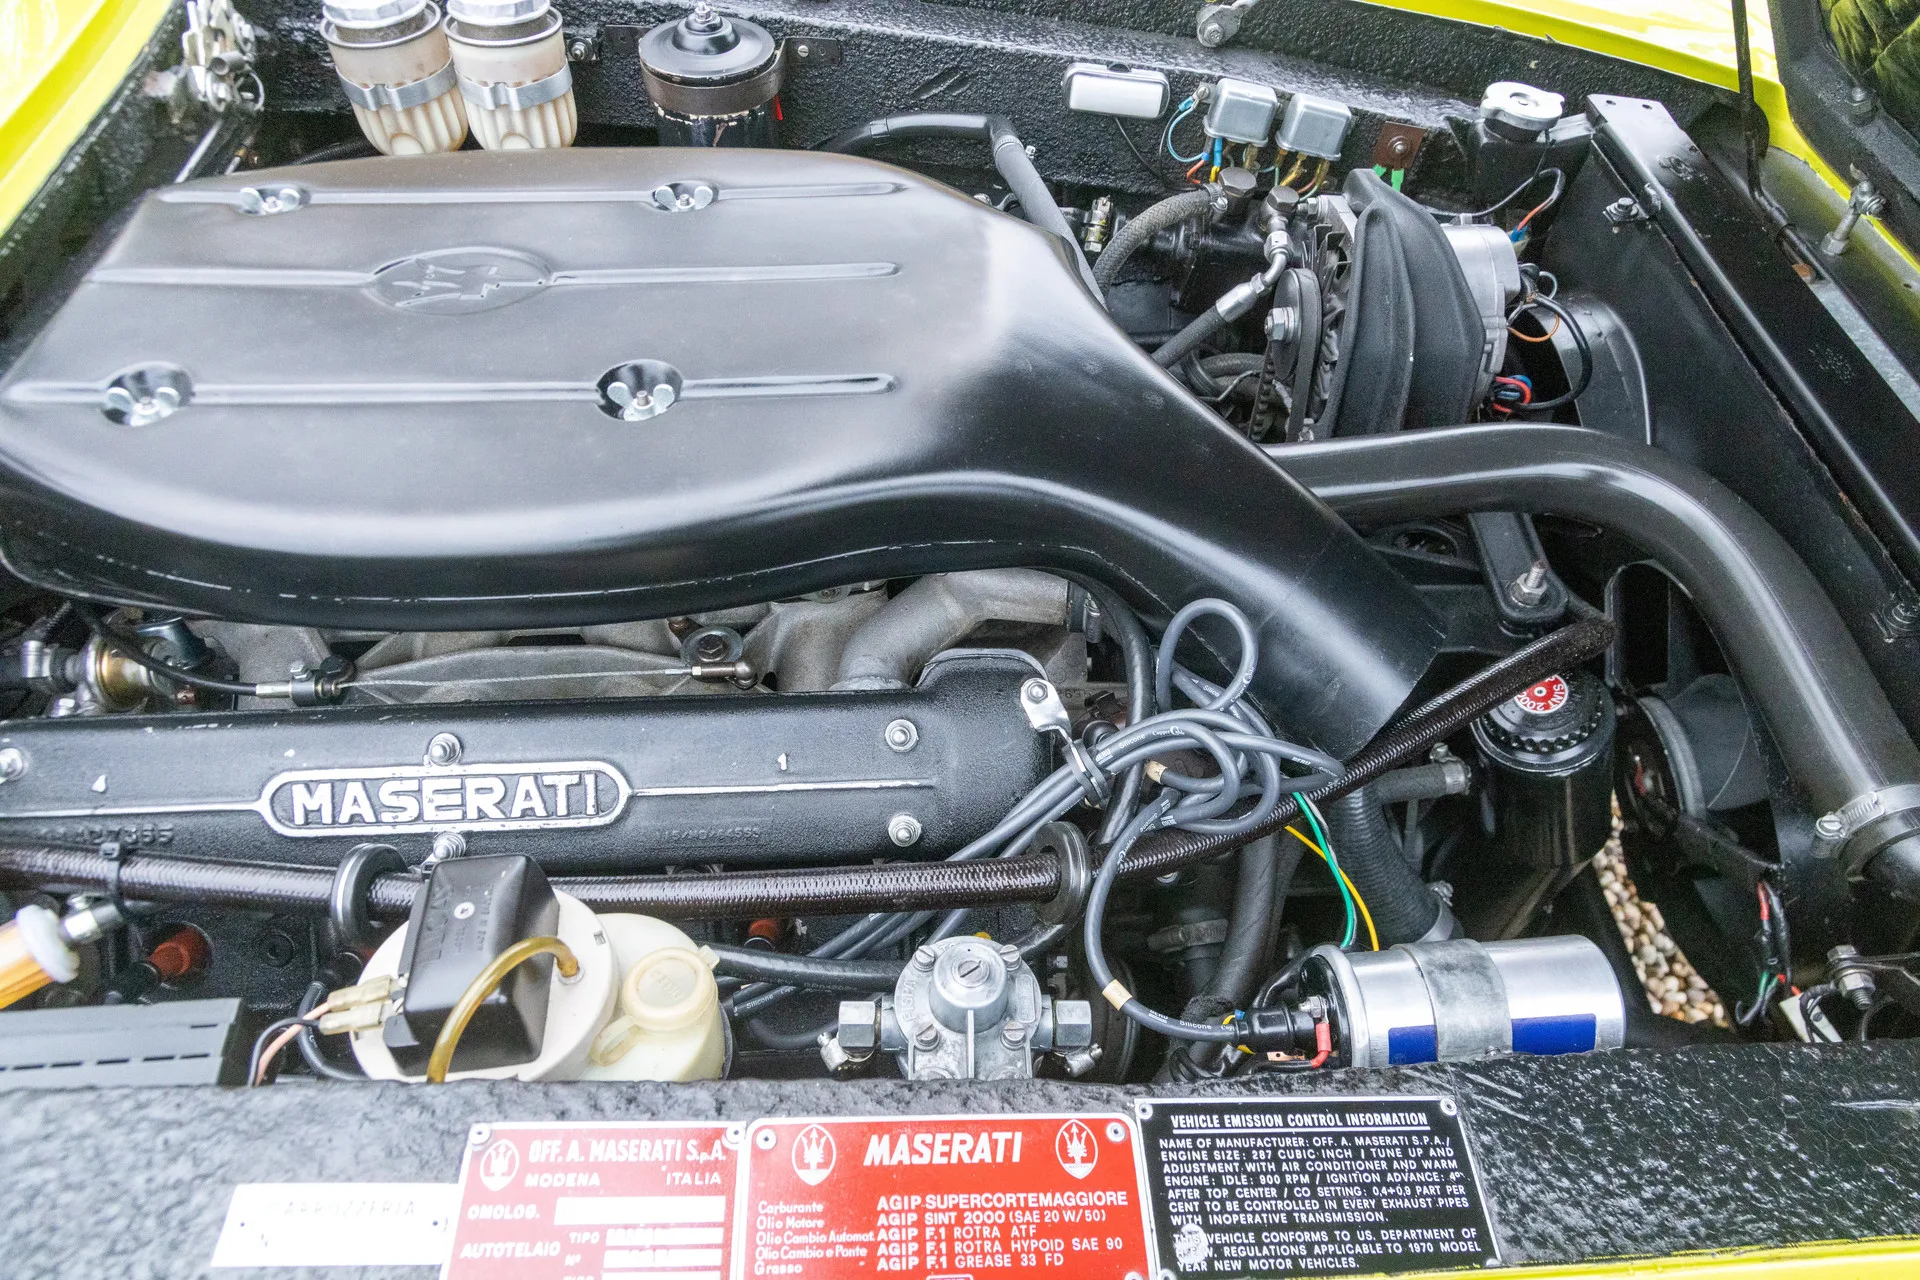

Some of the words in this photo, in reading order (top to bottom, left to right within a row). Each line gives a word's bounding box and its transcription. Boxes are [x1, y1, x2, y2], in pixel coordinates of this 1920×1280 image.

[1547, 684, 1565, 709] SINT
[1119, 734, 1145, 749] Silicone
[291, 773, 598, 826] MASERATI
[747, 994, 774, 1009] Silicone
[1180, 1020, 1212, 1030] Silicone
[1170, 1114, 1220, 1128] VEHICLE
[1223, 1114, 1283, 1128] EMISSION
[1287, 1113, 1343, 1127] CONTROL
[1345, 1112, 1428, 1126] INFORMATION
[864, 1131, 1023, 1166] MASERATI
[1159, 1138, 1193, 1149] NAME
[1196, 1138, 1212, 1149] OF
[1216, 1136, 1310, 1148] MANUFACTURER:
[1312, 1136, 1338, 1147] OFF.
[1341, 1136, 1351, 1147] A.
[1354, 1136, 1409, 1147] MASERATI
[528, 1139, 563, 1163] OFF.
[566, 1139, 584, 1162] A.
[589, 1139, 681, 1162] MASERATI
[1161, 1150, 1208, 1161] ENGINE
[1213, 1150, 1246, 1161] SIZE:
[1252, 1150, 1272, 1160] 287
[1277, 1149, 1315, 1160] CUBIC
[1322, 1148, 1352, 1160] INCH
[1370, 1148, 1404, 1158] TUNE
[1409, 1148, 1423, 1158] UP
[1429, 1147, 1454, 1157] AND
[1163, 1162, 1240, 1174] ADJUSTMENT
[1245, 1161, 1276, 1173] WITH
[1281, 1161, 1300, 1172] AIR
[1306, 1160, 1388, 1172] CONDITIONER
[1393, 1160, 1417, 1170] AND
[1421, 1159, 1458, 1170] WARM
[524, 1172, 600, 1187] MODENA
[666, 1172, 721, 1185] ITALIA
[1164, 1175, 1215, 1187] ENGINE:
[1222, 1174, 1254, 1186] IDLE:
[1260, 1174, 1281, 1185] 900
[1285, 1173, 1310, 1184] RPM
[1326, 1172, 1381, 1184] IGNITION
[1387, 1171, 1445, 1183] ADVANCE:
[1168, 1188, 1200, 1200] AFTER
[1206, 1188, 1229, 1199] TOP
[1235, 1187, 1278, 1198] CENTER
[1293, 1186, 1311, 1198] CO
[1317, 1186, 1367, 1198] SETTING:
[1416, 1185, 1441, 1196] PART
[1446, 1184, 1466, 1195] PER
[758, 1200, 824, 1215] Carburante
[877, 1195, 922, 1211] AGIP
[925, 1191, 1128, 1209] SUPERCORTEMAGGIORE
[1169, 1201, 1199, 1213] CENT
[1204, 1201, 1221, 1212] TO
[1226, 1200, 1240, 1212] BE
[1244, 1200, 1320, 1212] CONTROLLED
[1325, 1199, 1337, 1210] IN
[1343, 1199, 1376, 1210] EVERY
[1382, 1198, 1432, 1209] EXHAUST
[1438, 1197, 1469, 1208] PIPES
[756, 1216, 783, 1230] Olio
[786, 1216, 825, 1229] Motore
[877, 1212, 918, 1227] AGIP
[925, 1211, 957, 1225] SINT
[964, 1211, 1006, 1224] 2000
[1009, 1210, 1040, 1223] (SAE
[1044, 1210, 1059, 1222] 20
[1170, 1214, 1202, 1226] WITH
[1209, 1213, 1288, 1225] INOPERATIVE
[1293, 1211, 1389, 1224] TRANSMISSION.
[569, 1231, 600, 1244] TIPO
[756, 1231, 782, 1246] Olio
[783, 1231, 827, 1245] Cambio
[829, 1229, 875, 1243] Automat.
[877, 1227, 918, 1241] AGIP
[925, 1226, 946, 1240] F.1
[954, 1226, 1001, 1239] ROTRA
[1010, 1225, 1037, 1238] ATF
[1207, 1232, 1256, 1244] VEHICLE
[1262, 1230, 1329, 1243] CONFORMS
[1334, 1231, 1350, 1242] TO
[1381, 1229, 1455, 1241] DEPARTMENT
[1461, 1228, 1477, 1239] OF
[460, 1241, 561, 1259] AUTOTELAIO
[755, 1246, 779, 1261] Olio
[780, 1245, 824, 1260] Cambio
[825, 1249, 834, 1258] e
[835, 1245, 868, 1258] Ponte
[877, 1242, 918, 1256] AGIP
[926, 1241, 947, 1255] F.1
[954, 1240, 1002, 1253] ROTRA
[1011, 1239, 1064, 1252] HYPOID
[1071, 1238, 1099, 1251] SAE
[1106, 1237, 1123, 1250] 90
[1224, 1245, 1307, 1257] REGULATIONS
[1314, 1243, 1383, 1255] APPLICABLE
[1386, 1243, 1402, 1254] TO
[1409, 1242, 1434, 1253] 1970
[1440, 1241, 1482, 1252] MODEL
[754, 1261, 803, 1275] Grasso
[877, 1257, 919, 1271] AGIP
[926, 1255, 947, 1269] F.1
[955, 1254, 1012, 1268] GREASE
[1020, 1253, 1037, 1266] 33
[1045, 1253, 1064, 1266] FD
[1177, 1260, 1208, 1272] YEAR
[1214, 1260, 1242, 1271] NEW
[1248, 1258, 1293, 1270] MOTOR
[1299, 1257, 1360, 1269] VEHICLES.
